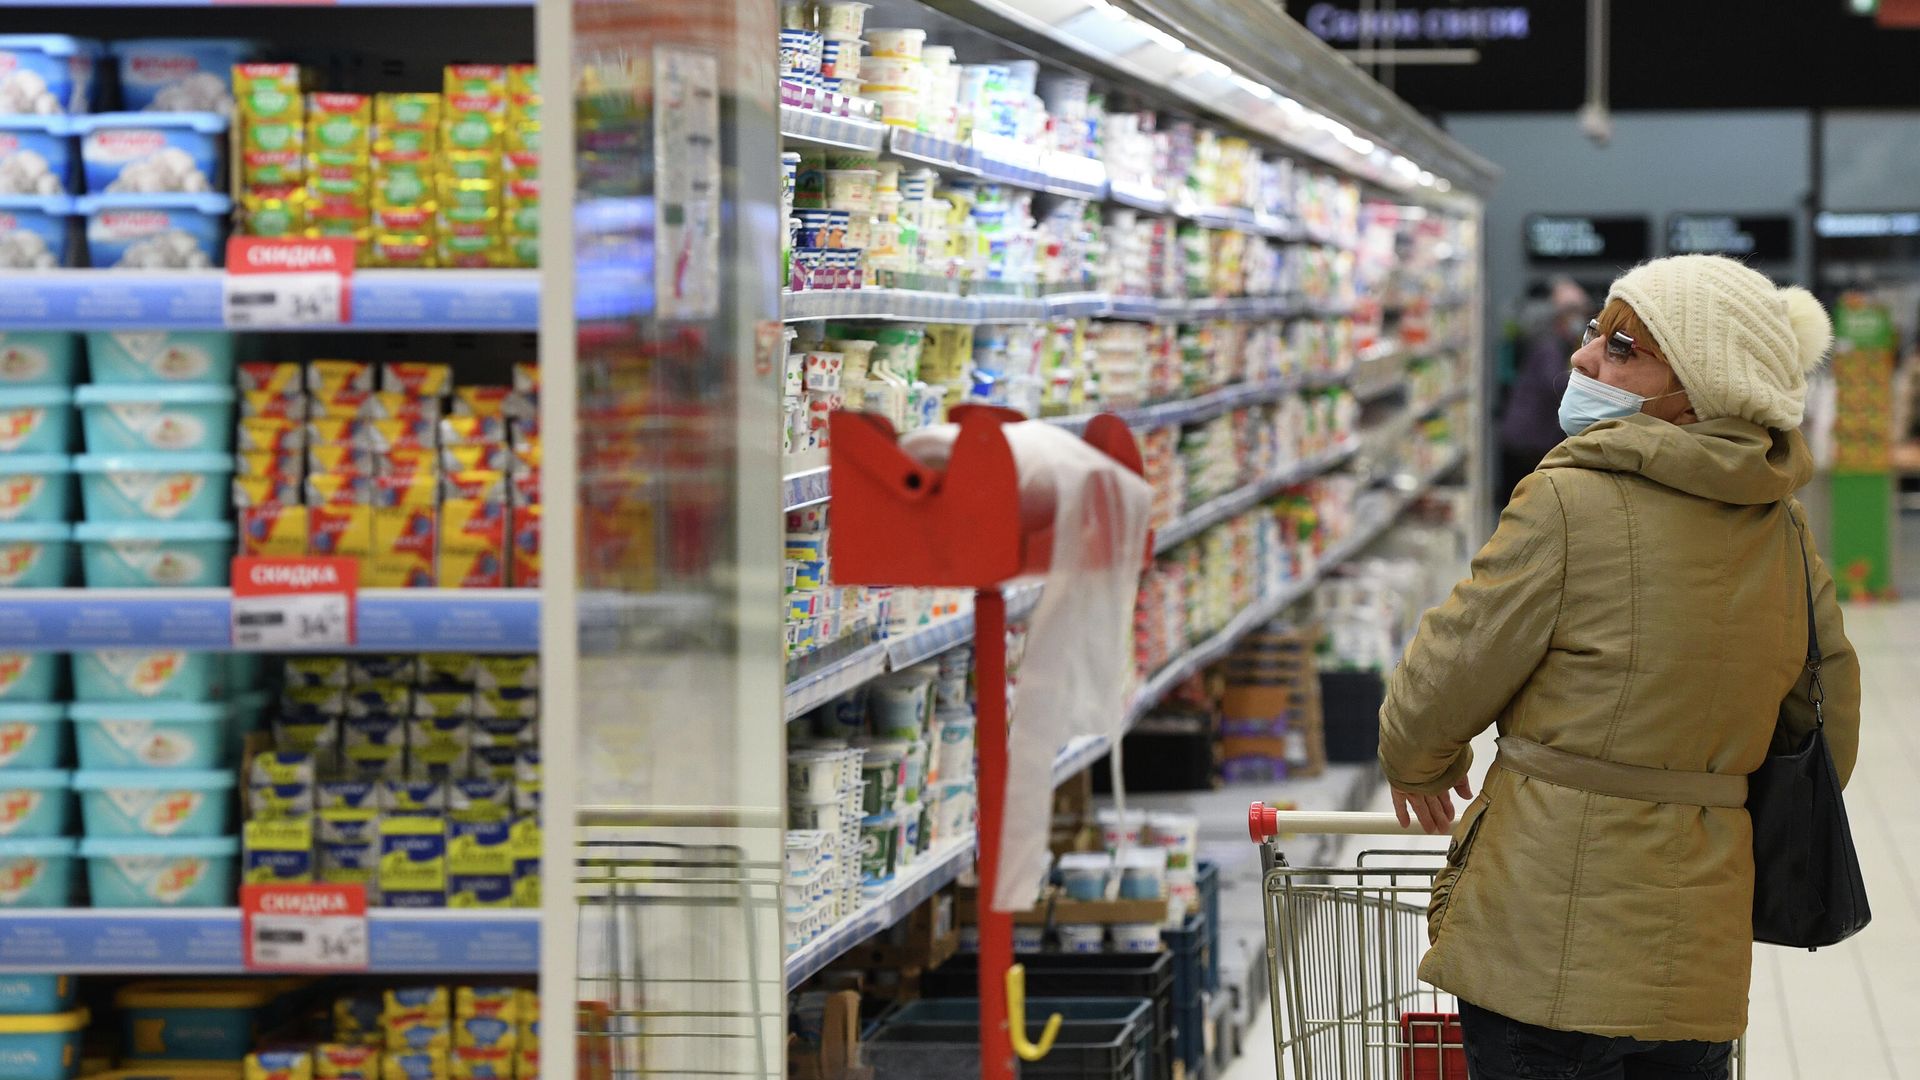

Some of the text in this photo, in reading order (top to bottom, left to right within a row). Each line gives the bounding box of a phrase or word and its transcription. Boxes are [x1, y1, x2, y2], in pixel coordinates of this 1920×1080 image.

[246, 244, 336, 267] СКИДКА
[251, 565, 338, 587] СКИДКА
[260, 892, 347, 913] СКИДКА
